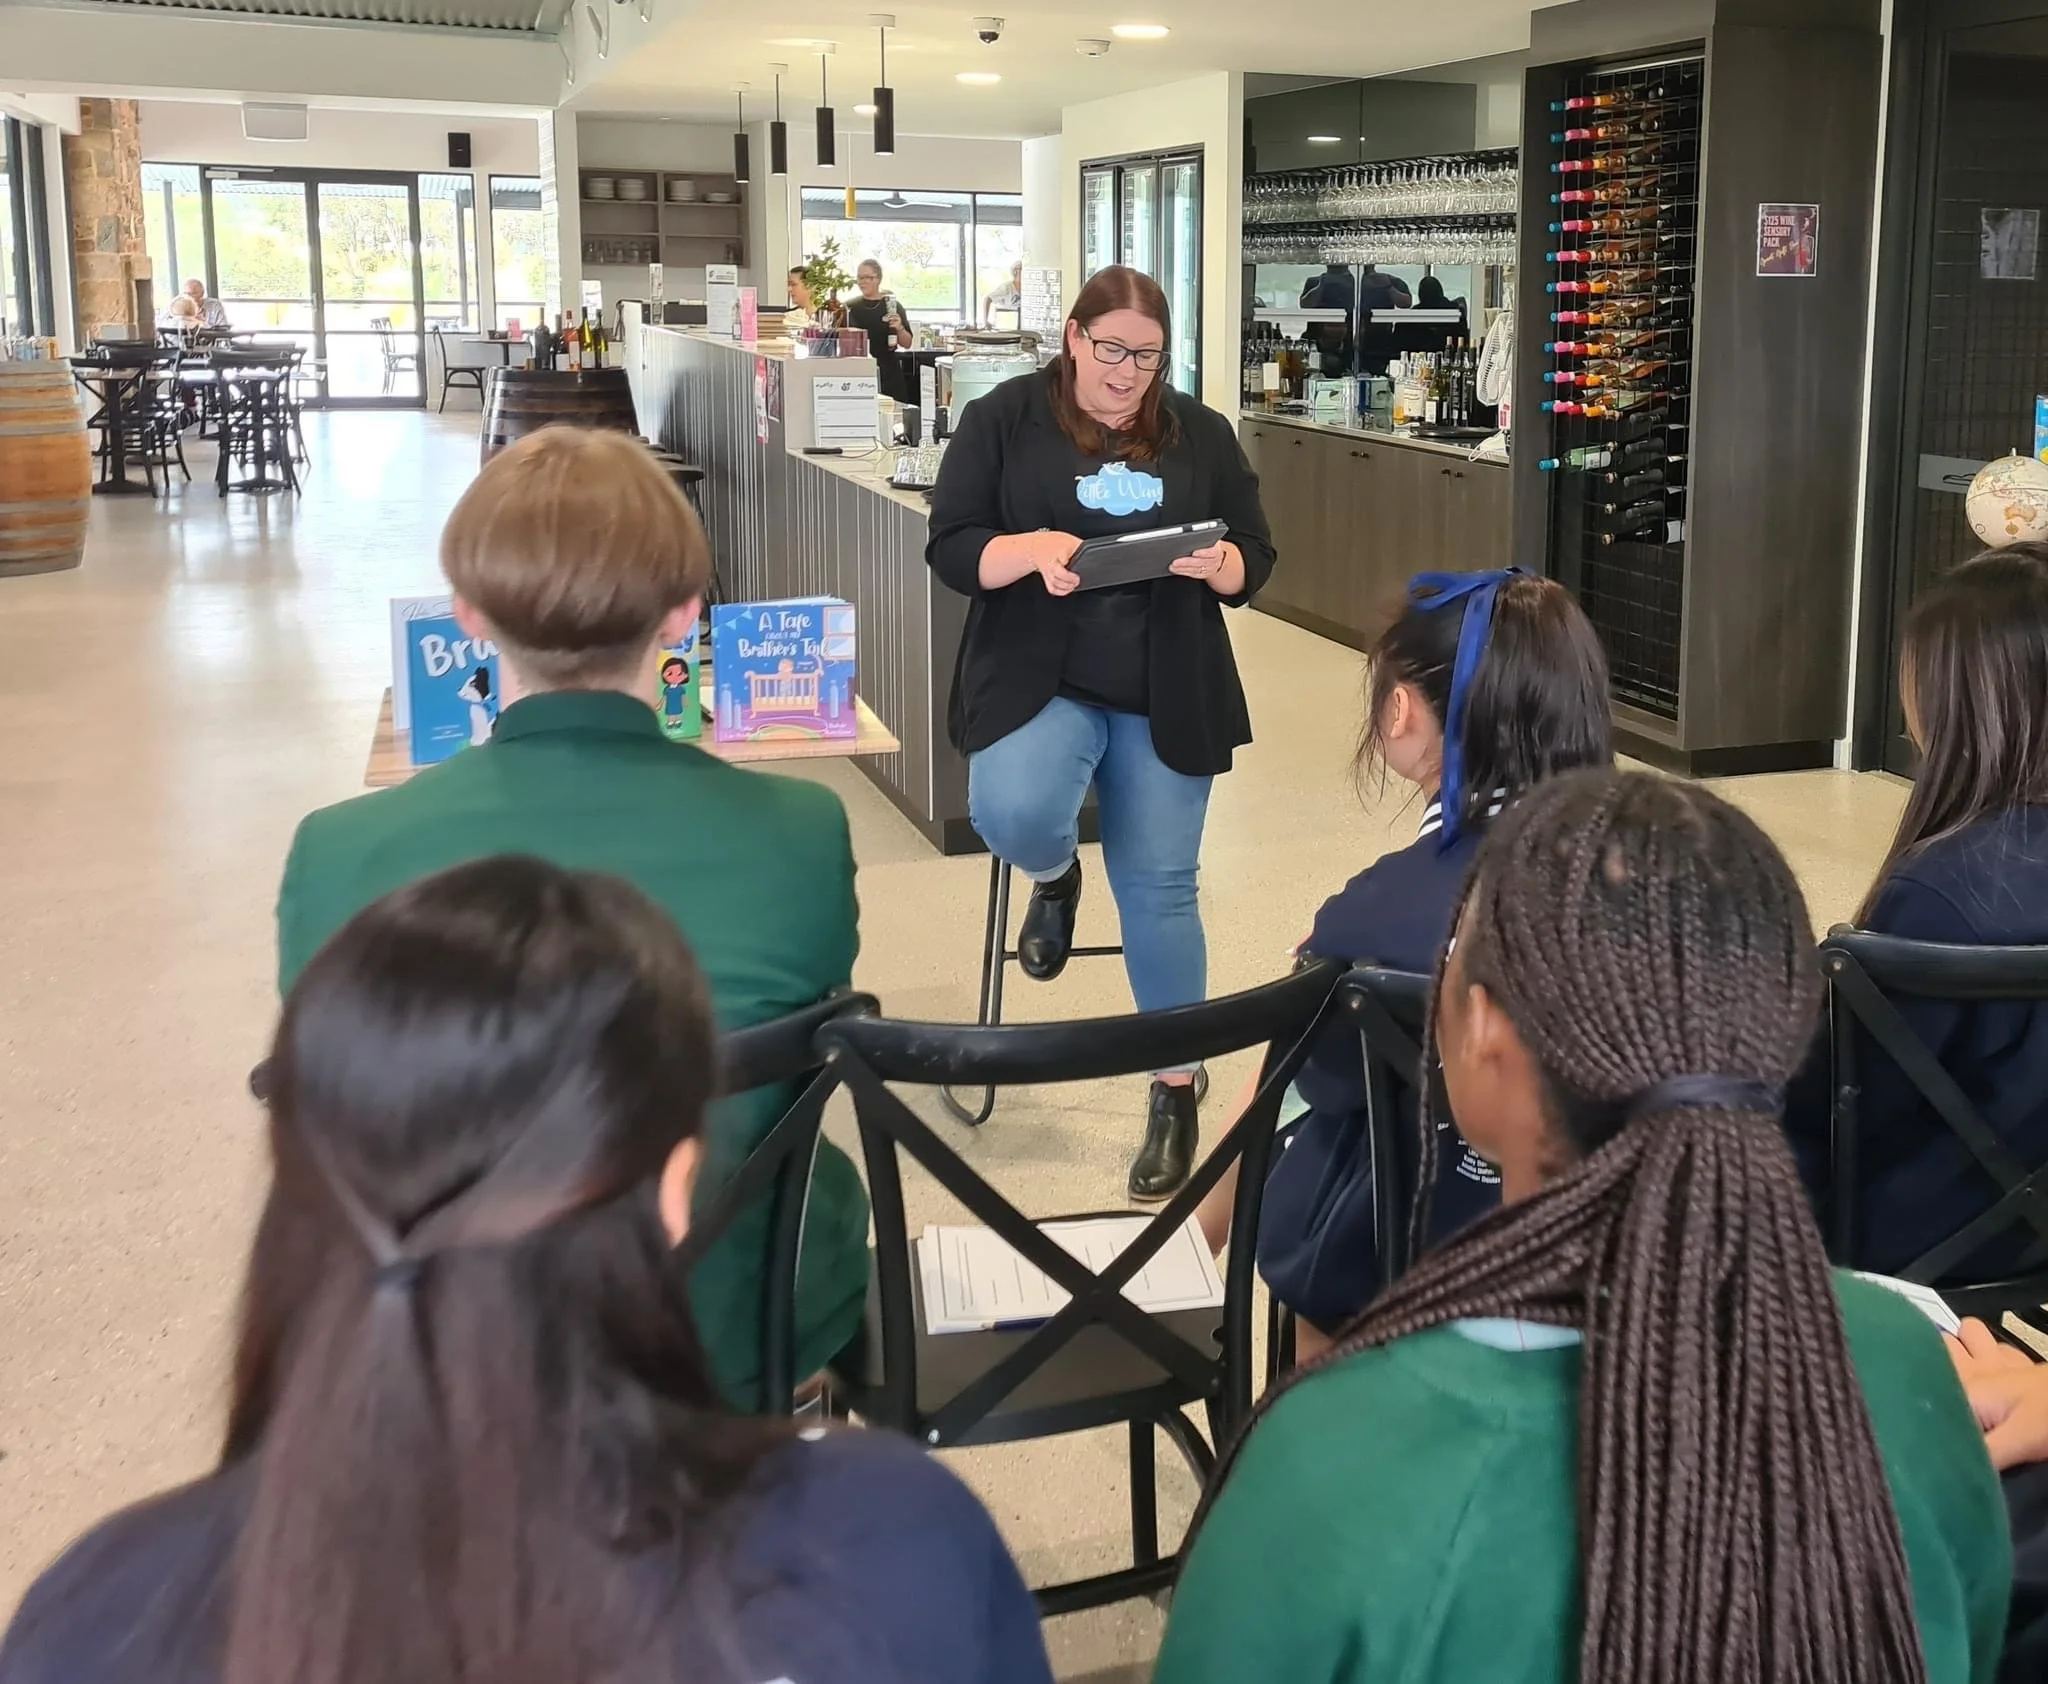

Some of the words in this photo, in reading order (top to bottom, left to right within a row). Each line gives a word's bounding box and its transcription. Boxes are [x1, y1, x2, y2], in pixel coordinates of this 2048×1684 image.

[1763, 237, 1780, 247] PACK
[758, 612, 773, 632] A
[737, 637, 797, 658] Brother's
